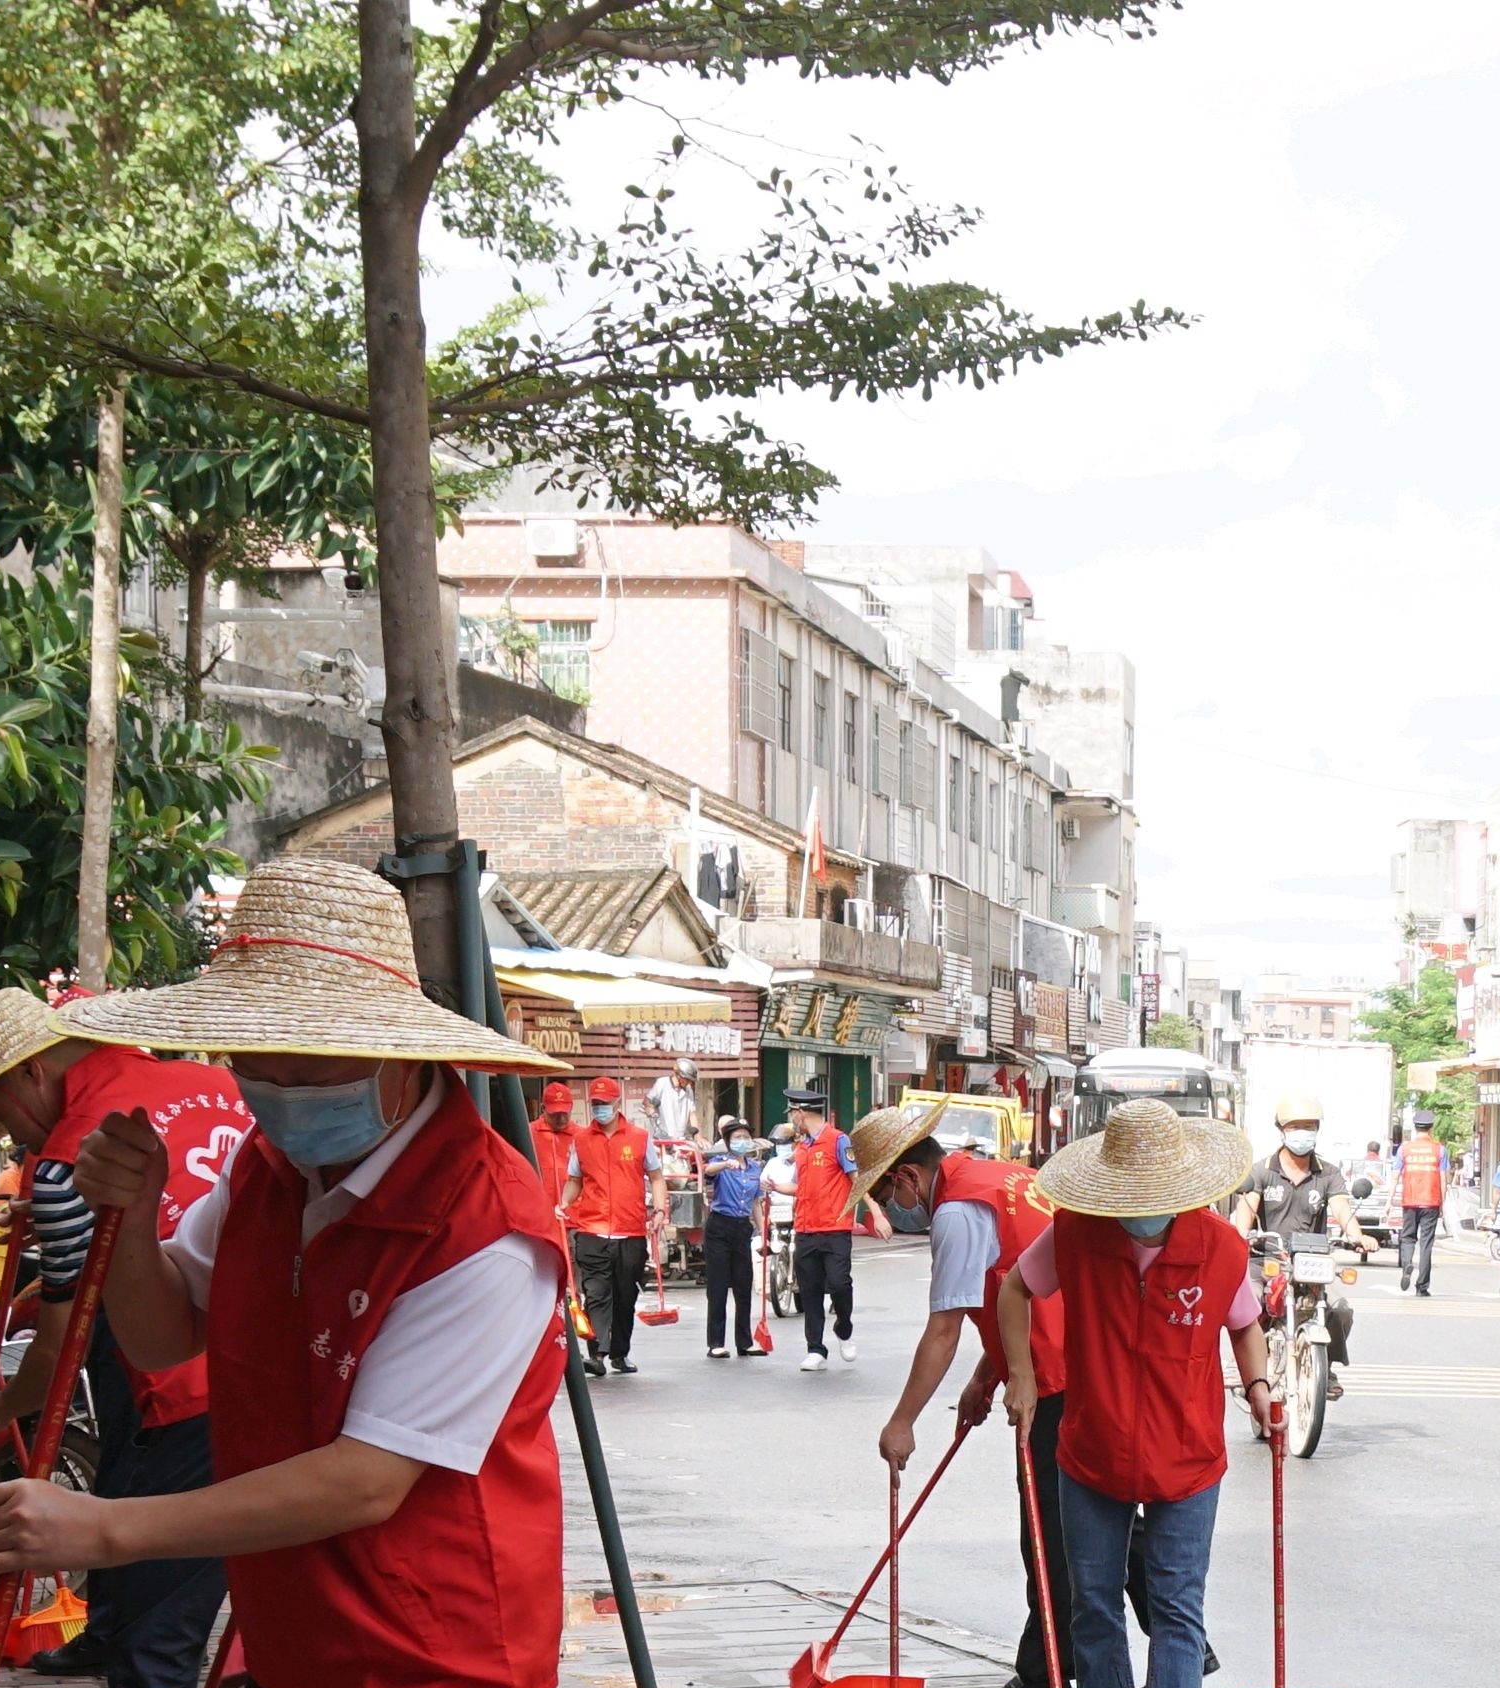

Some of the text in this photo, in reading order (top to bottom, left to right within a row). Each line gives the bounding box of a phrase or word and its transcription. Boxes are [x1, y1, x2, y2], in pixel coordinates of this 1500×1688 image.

[527, 1030, 583, 1054] HONDA
[1167, 1310, 1204, 1326] 志愿者
